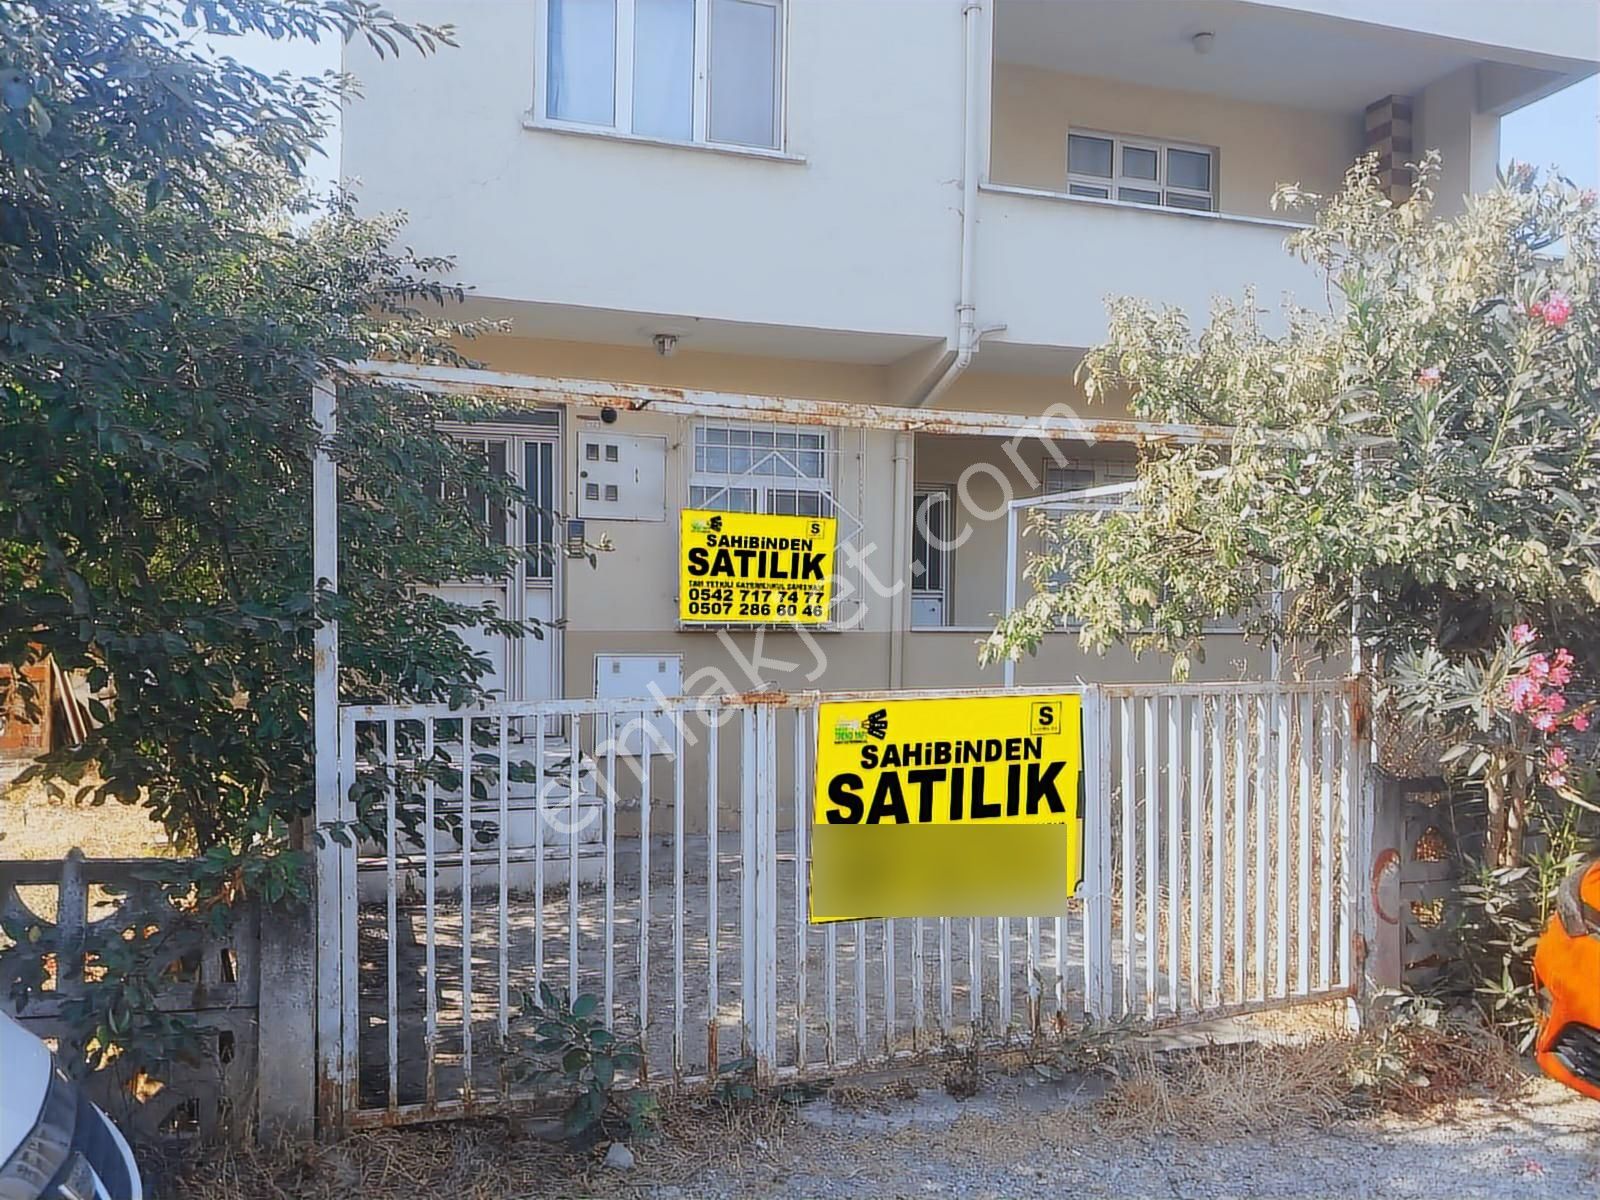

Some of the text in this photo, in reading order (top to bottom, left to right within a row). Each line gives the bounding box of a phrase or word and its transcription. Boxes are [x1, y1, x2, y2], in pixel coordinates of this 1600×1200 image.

[811, 523, 820, 534] S
[688, 547, 827, 580] SATILIK
[689, 588, 824, 604] 0542 717 74 77
[688, 602, 733, 615] 0507
[739, 603, 771, 616] 286
[802, 605, 822, 617] 46
[1039, 706, 1054, 726] S
[825, 760, 1067, 824] SATILIK
